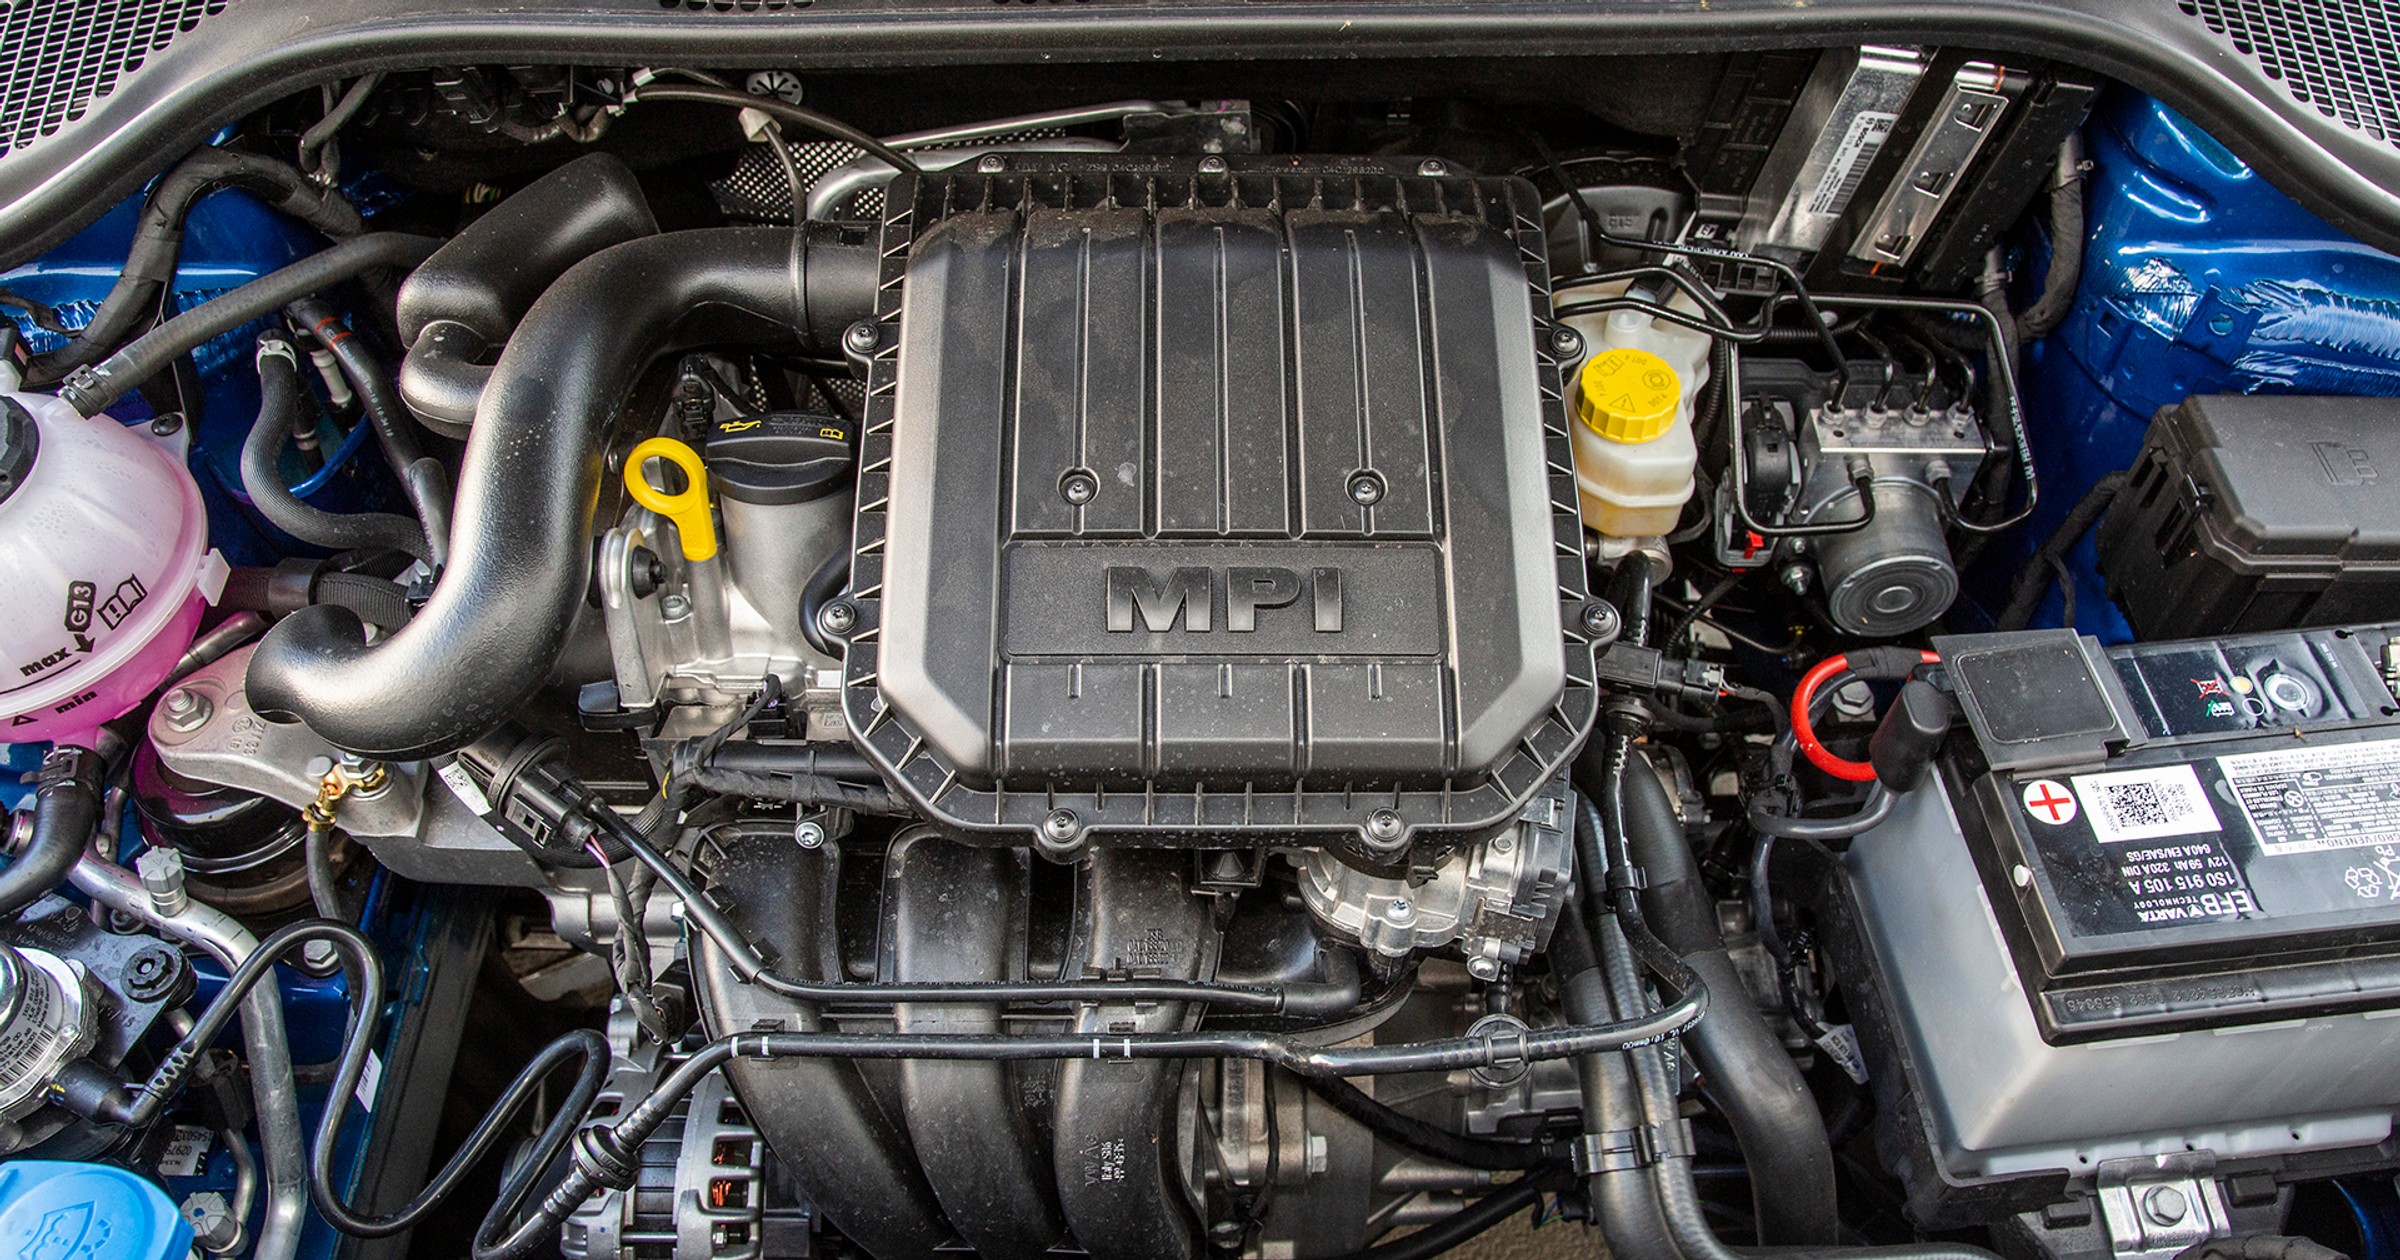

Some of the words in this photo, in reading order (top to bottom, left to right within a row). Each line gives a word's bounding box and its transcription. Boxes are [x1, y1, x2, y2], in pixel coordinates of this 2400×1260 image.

[71, 584, 92, 626] G13
[1106, 566, 1342, 632] MPI
[19, 647, 73, 677] max
[55, 691, 98, 714] min
[2126, 848, 2182, 863] EN/SAE/GS
[2182, 844, 2211, 856] 640A
[2374, 843, 2395, 858] Pb
[2174, 859, 2203, 871] 59Ah
[2208, 856, 2228, 868] 12V
[2121, 865, 2141, 878] DIN
[2128, 881, 2142, 895] A
[2144, 877, 2173, 893] 105
[2175, 874, 2205, 890] 915
[2133, 896, 2199, 909] TECHNOLOGY
[2200, 890, 2254, 915] EFB
[2137, 908, 2188, 923] VARTA
